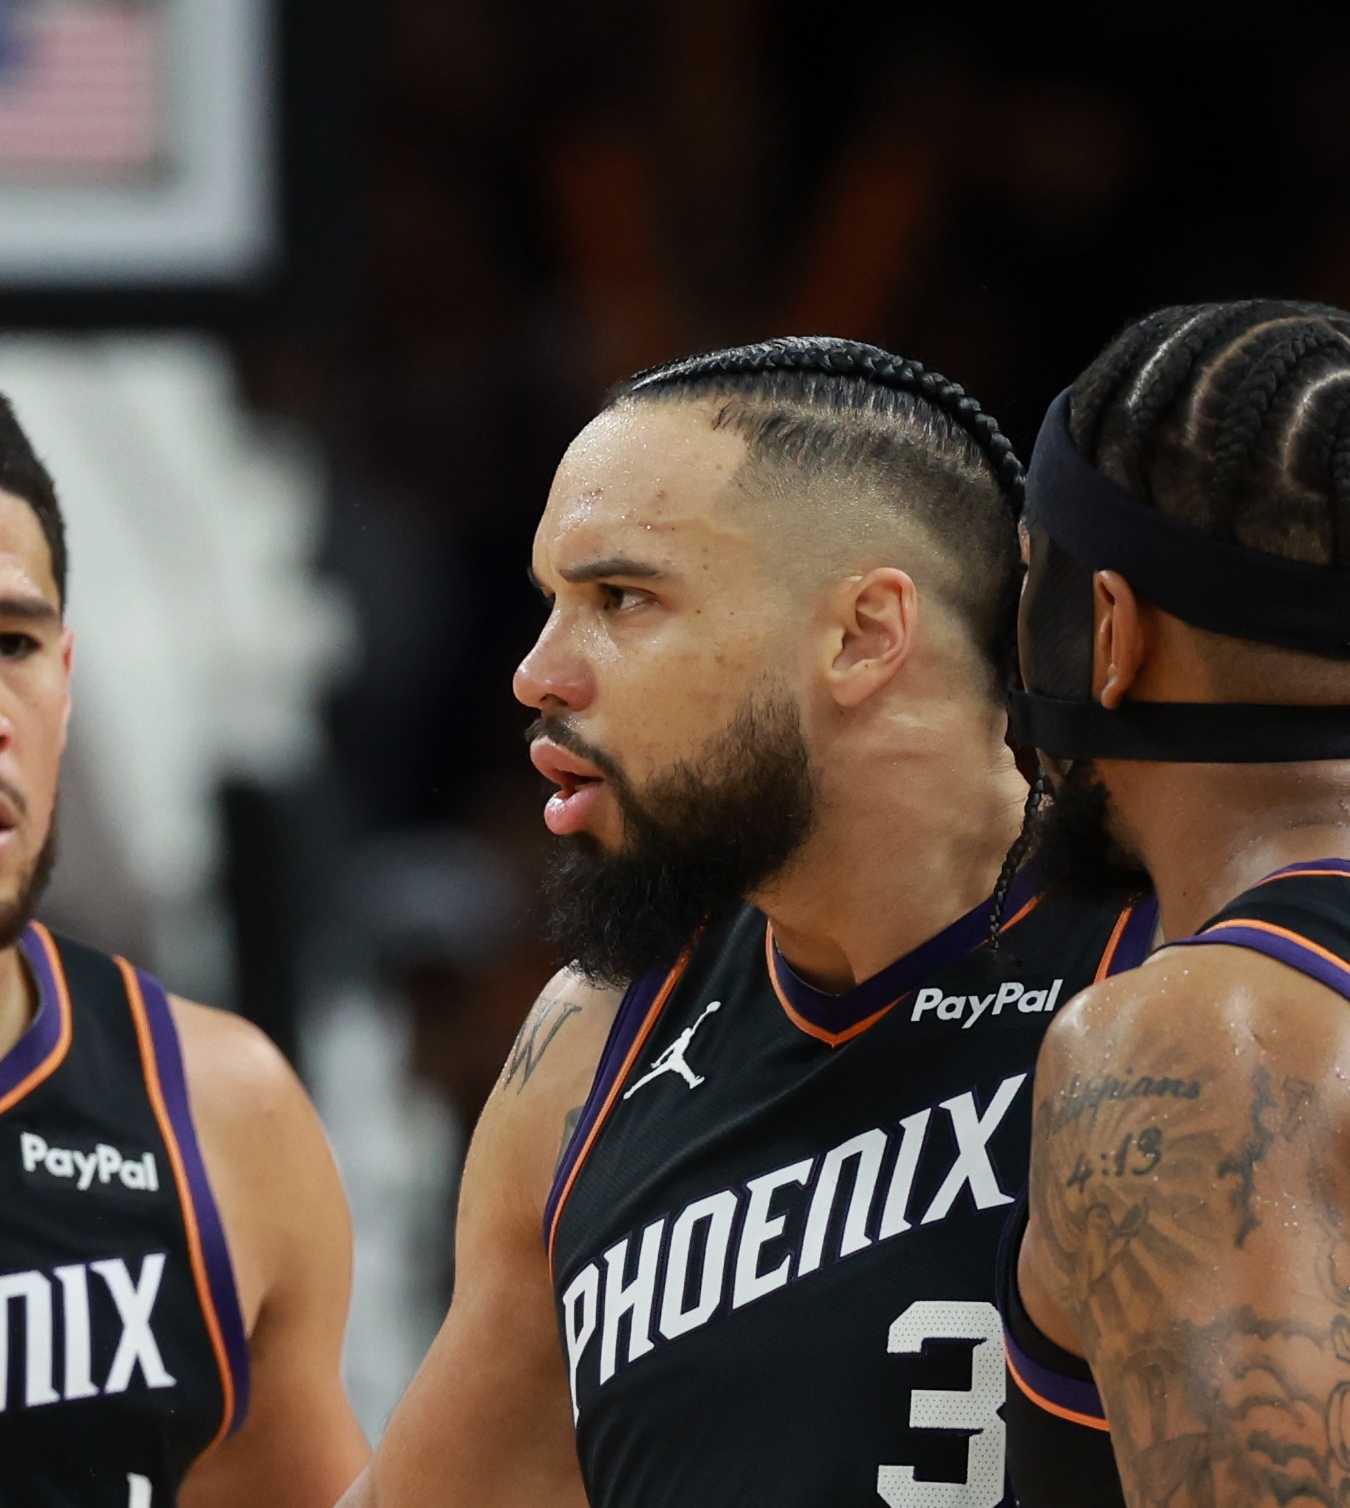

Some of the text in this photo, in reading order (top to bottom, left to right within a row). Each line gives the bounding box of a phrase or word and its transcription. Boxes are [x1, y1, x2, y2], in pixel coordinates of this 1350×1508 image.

[911, 979, 1063, 1030] PayPal
[20, 1131, 160, 1191] PayPal
[563, 1071, 1030, 1430] PHOENIX
